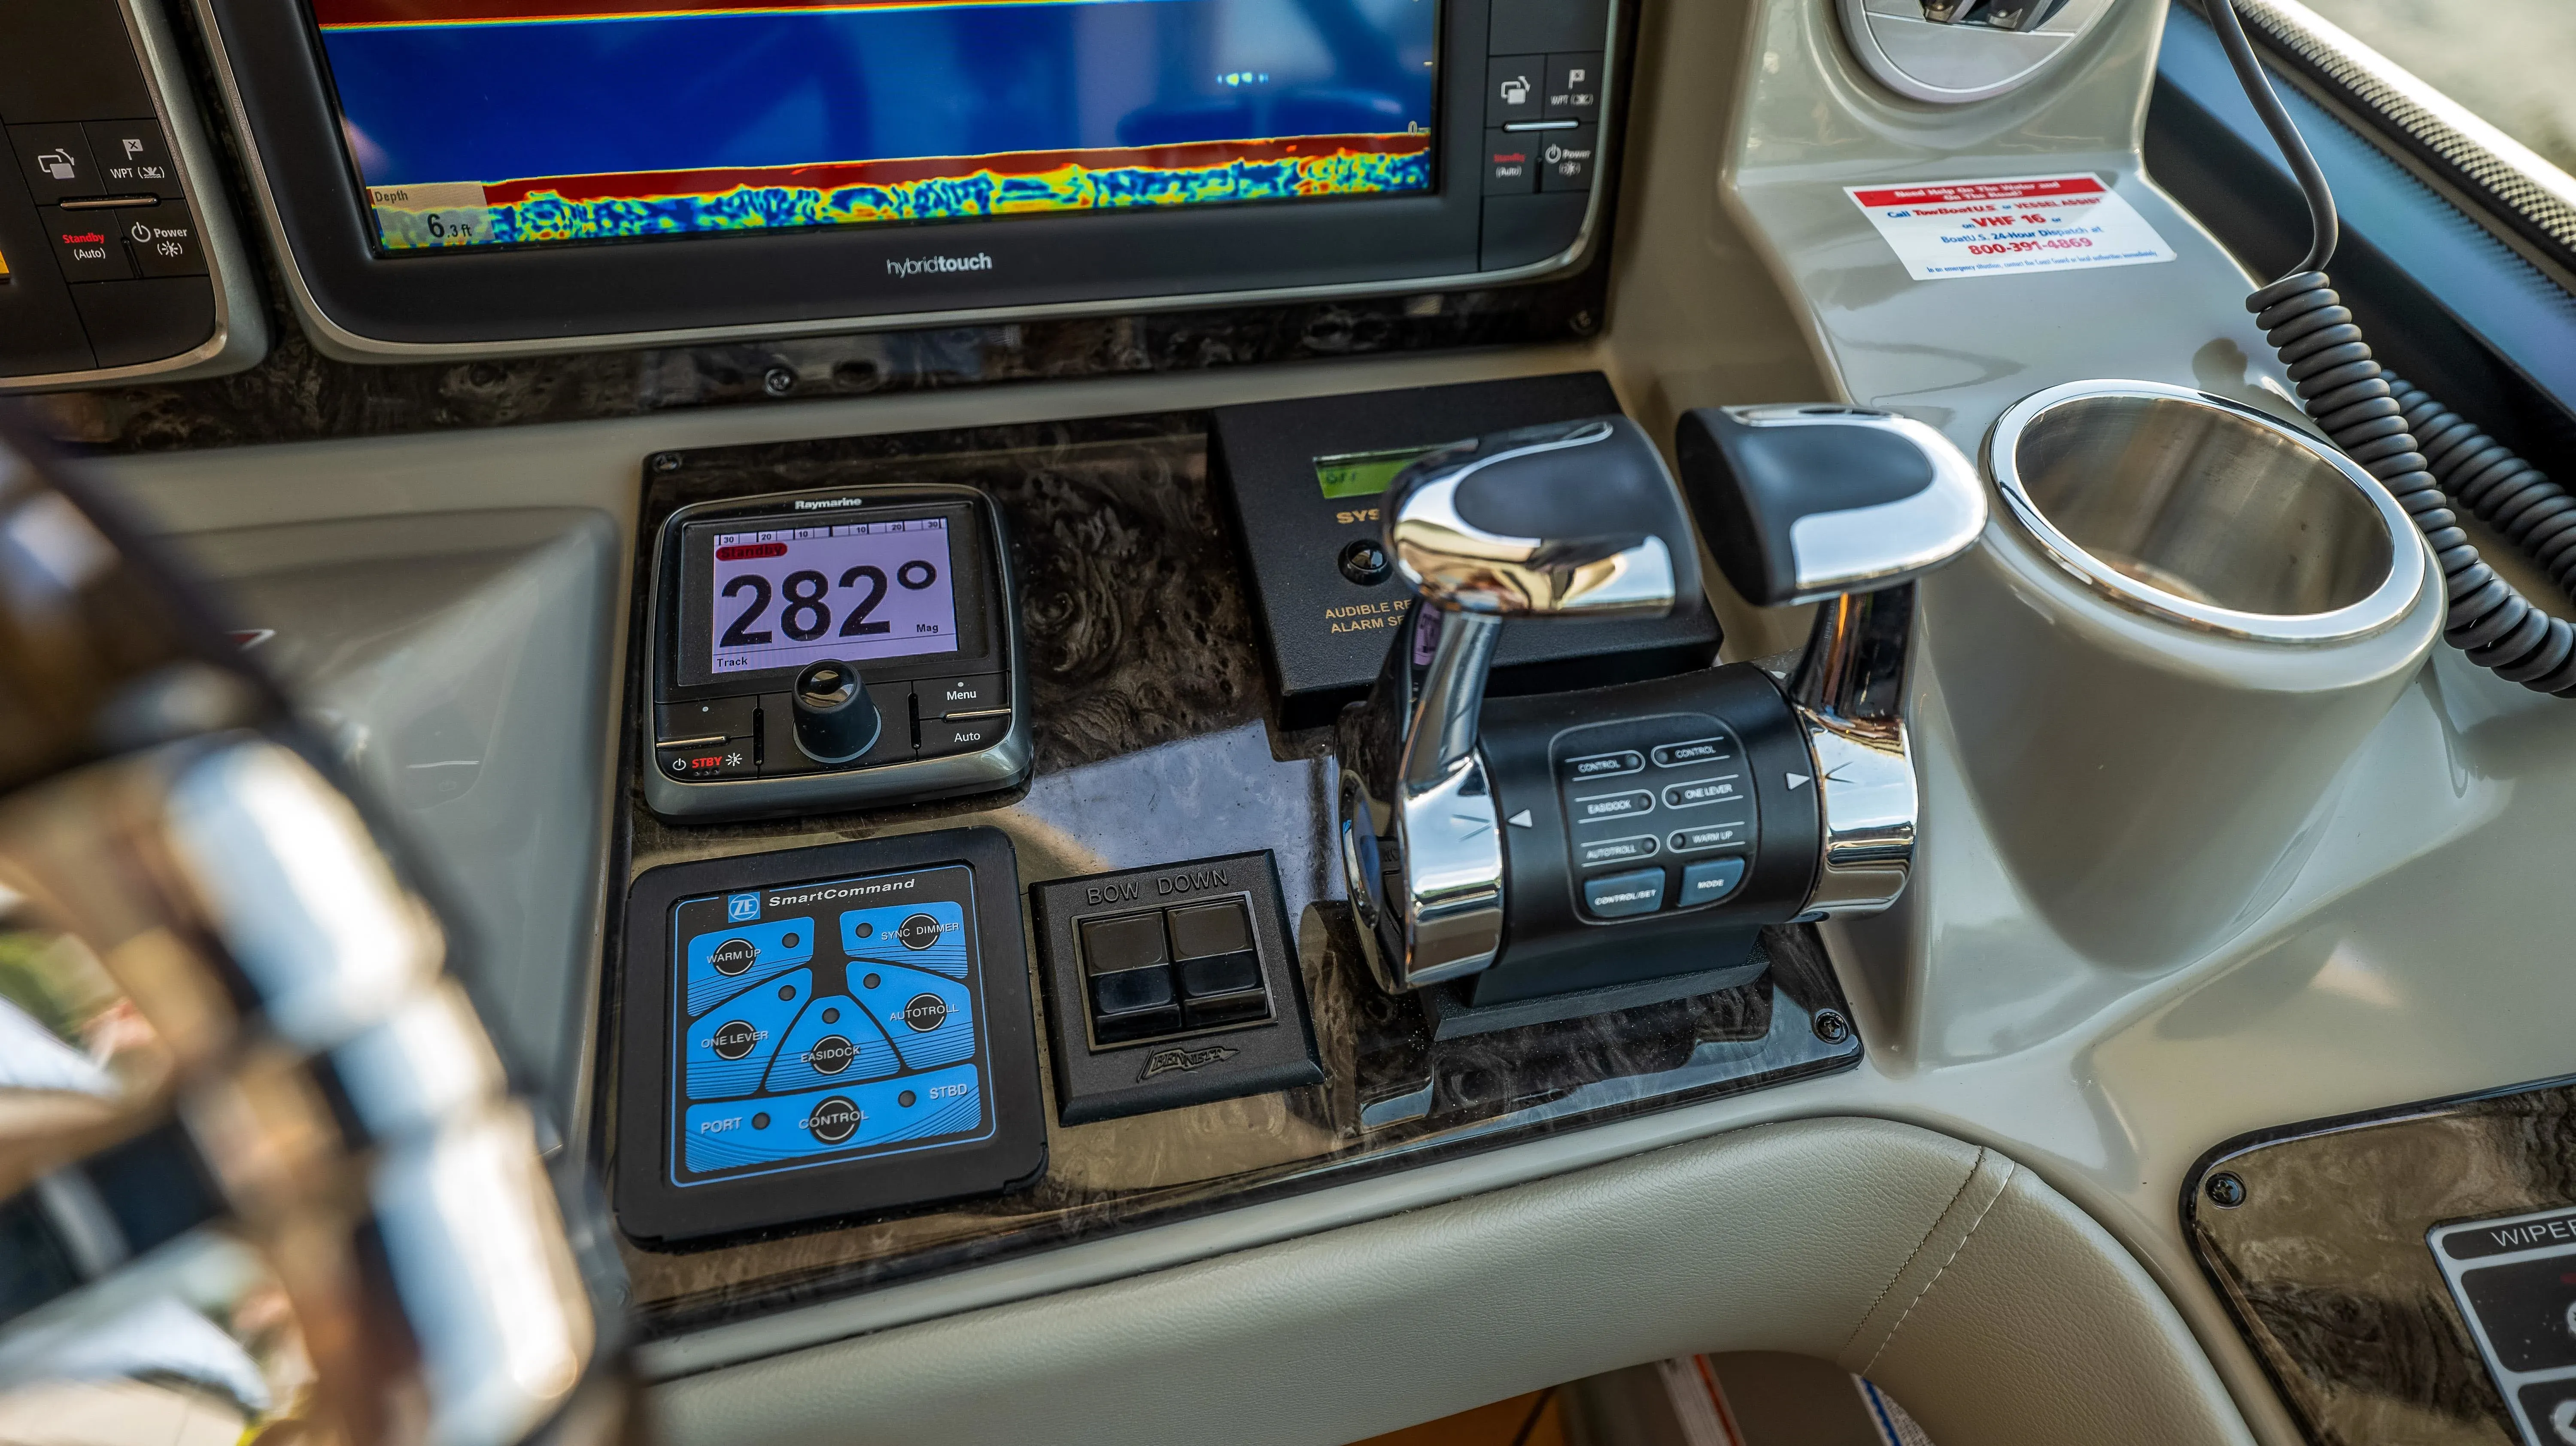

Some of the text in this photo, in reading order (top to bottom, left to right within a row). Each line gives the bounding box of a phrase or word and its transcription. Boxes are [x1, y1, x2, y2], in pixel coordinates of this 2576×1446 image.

[110, 168, 133, 179] WPT
[374, 190, 408, 204] Depth
[1887, 210, 1911, 218] Call
[2014, 200, 2060, 210] VESSEL
[1971, 215, 2016, 227] VHF
[2020, 213, 2047, 224] 16
[153, 228, 187, 237] Power
[461, 223, 472, 237] ft
[1991, 231, 2035, 240] 24-Hour
[2038, 226, 2088, 237] Dispatch
[62, 233, 104, 244] Standby
[1968, 237, 2093, 255] 800-391-4869
[73, 247, 106, 260] (Auto)
[887, 252, 992, 278] hybridtouch
[795, 497, 862, 510] Raymarine
[1336, 508, 1381, 524] SYS
[720, 543, 783, 558] Standby
[1325, 602, 1390, 619] AUDIBLE
[916, 623, 939, 635] Mag
[1331, 617, 1384, 634] ALARM
[717, 656, 748, 667] Track
[947, 689, 977, 701] Menu
[954, 731, 981, 742] Auto
[1675, 746, 1716, 758] CONTROL
[692, 756, 722, 768] STBY
[1578, 759, 1621, 772] CONTROL
[1685, 784, 1733, 799] ONE LEVER
[1692, 830, 1733, 844] WARM UP
[1586, 845, 1636, 859] AUTOTROLL
[1086, 869, 1228, 904] BOW DOWN
[1697, 879, 1724, 889] MODE
[769, 879, 915, 907] SmartCommand
[1595, 889, 1657, 905] CONTROL/SET
[881, 922, 960, 941] SYNC DIMMER
[707, 948, 762, 964] WARM UP
[890, 1004, 959, 1022] AUTOTROLL
[701, 1030, 769, 1049] ONE LEVER
[800, 1045, 860, 1063] EASIDOCK
[1151, 1049, 1222, 1072] BENNETT
[930, 1083, 968, 1100] STBD
[701, 1117, 743, 1134] PORT
[799, 1110, 869, 1130] CONTROL
